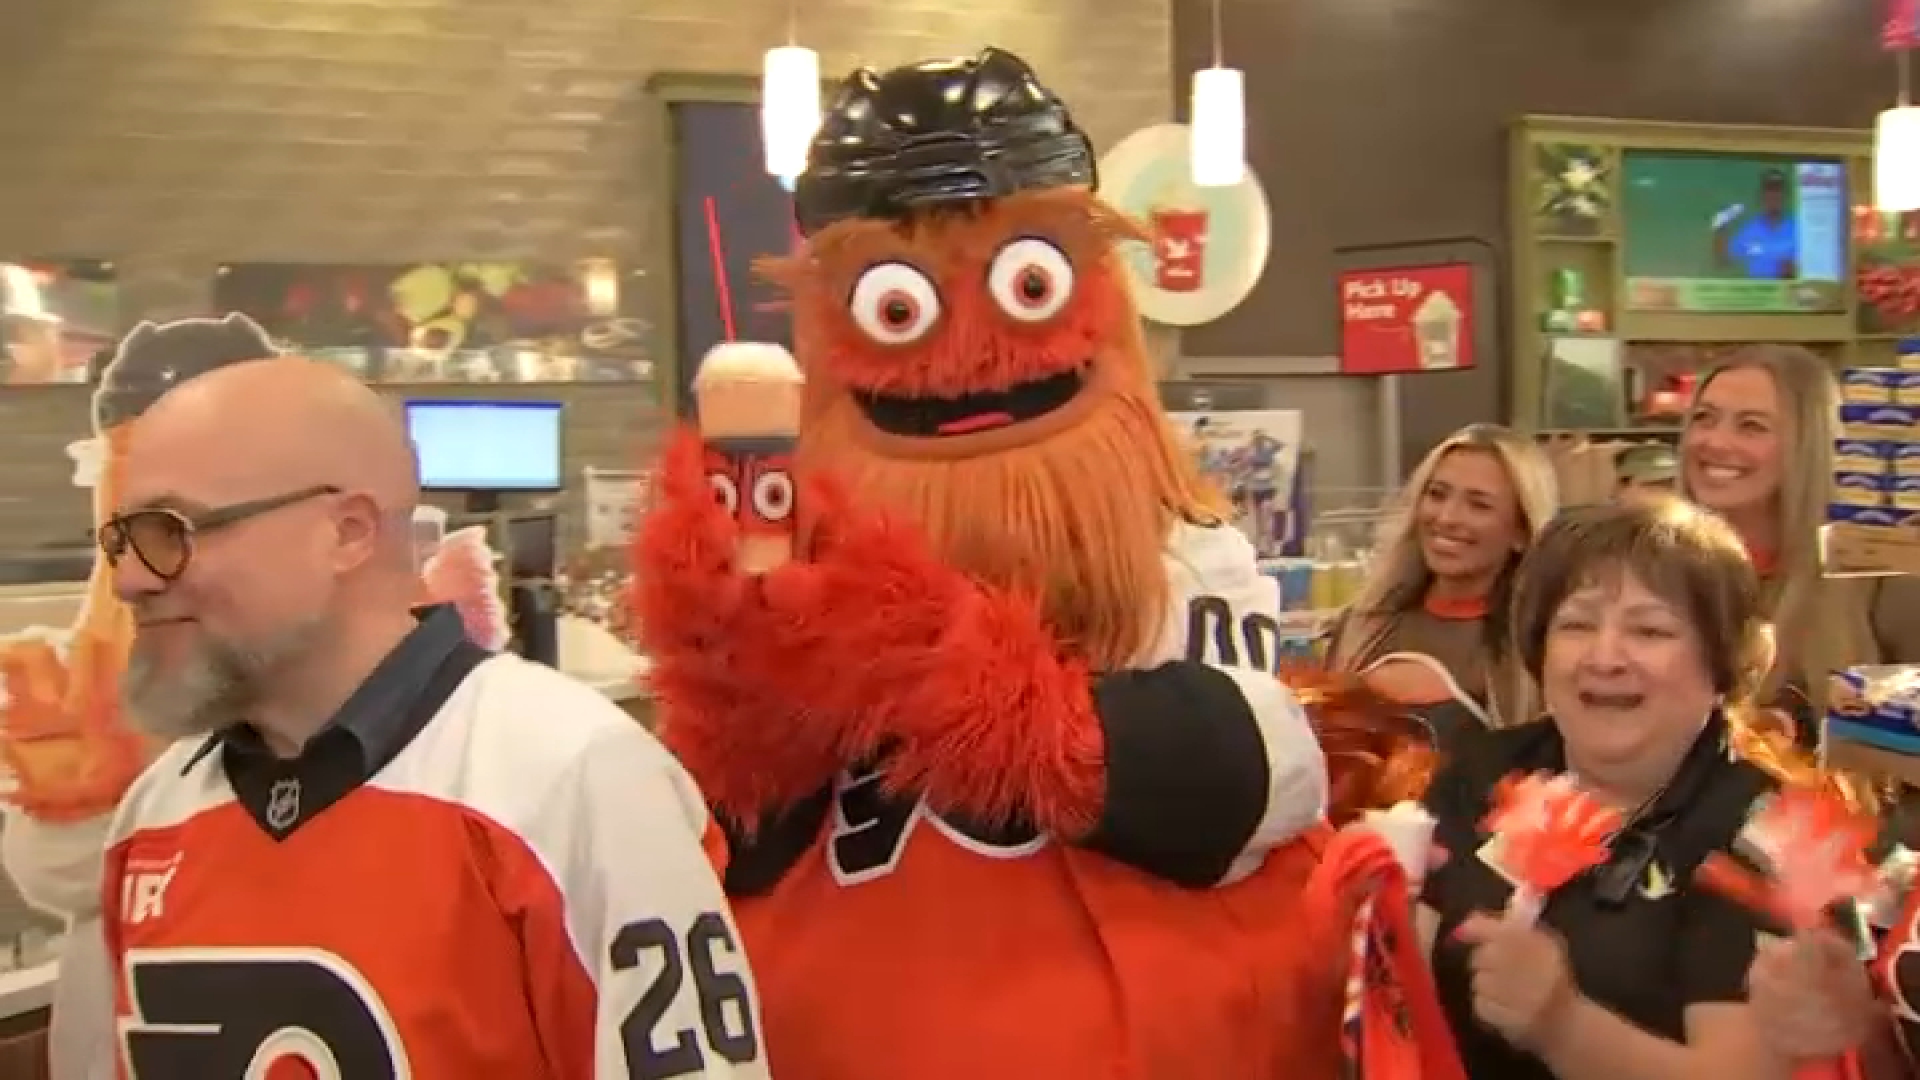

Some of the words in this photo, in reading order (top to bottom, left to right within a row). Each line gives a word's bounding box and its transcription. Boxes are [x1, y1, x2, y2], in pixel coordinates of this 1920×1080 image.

[1344, 279, 1384, 298] Pick
[1391, 278, 1421, 299] Up
[1344, 302, 1395, 319] Here
[610, 912, 757, 1080] 26
